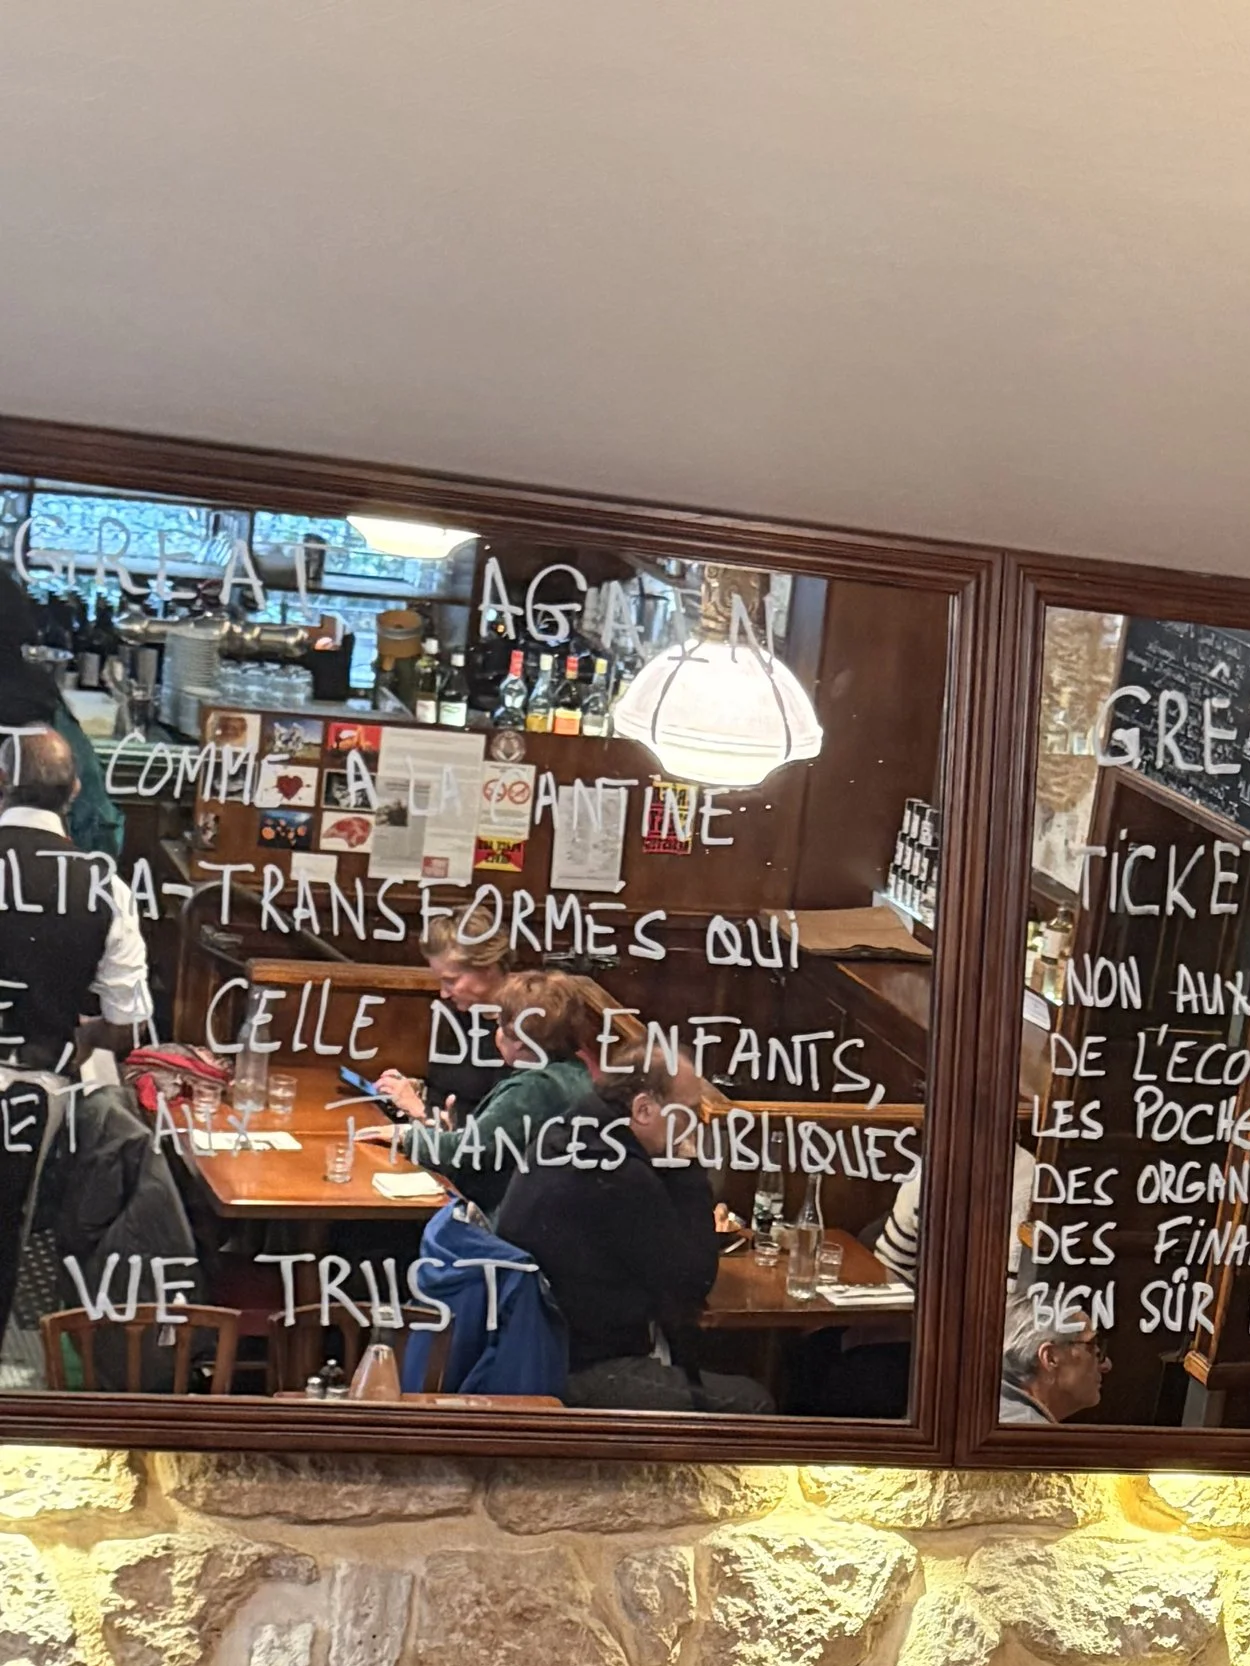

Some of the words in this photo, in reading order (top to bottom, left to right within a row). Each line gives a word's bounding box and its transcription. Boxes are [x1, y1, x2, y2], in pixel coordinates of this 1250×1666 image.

[14, 515, 345, 617] GREAT
[480, 556, 776, 670] AGAIN
[105, 730, 290, 808] COMME
[406, 756, 462, 818] LA
[490, 768, 734, 845] CANTINE
[706, 910, 799, 969] QUI
[1067, 954, 1141, 1009] NON
[205, 977, 386, 1060] CELLE
[429, 999, 549, 1069] DES
[597, 1008, 886, 1110] ENFANTS,
[1051, 1033, 1107, 1077] DE
[1, 1078, 103, 1153] ET
[152, 1091, 261, 1157] AUX
[324, 1094, 631, 1173] FINANCES
[651, 1103, 923, 1183] PUBLIQUES
[1032, 1095, 1103, 1139] LES
[1033, 1163, 1119, 1205] DES
[1032, 1220, 1117, 1265] DES
[64, 1254, 198, 1324] WE
[253, 1253, 540, 1332] TRUST
[1027, 1281, 1116, 1334] BIEN
[1140, 1267, 1215, 1335] SÛR
